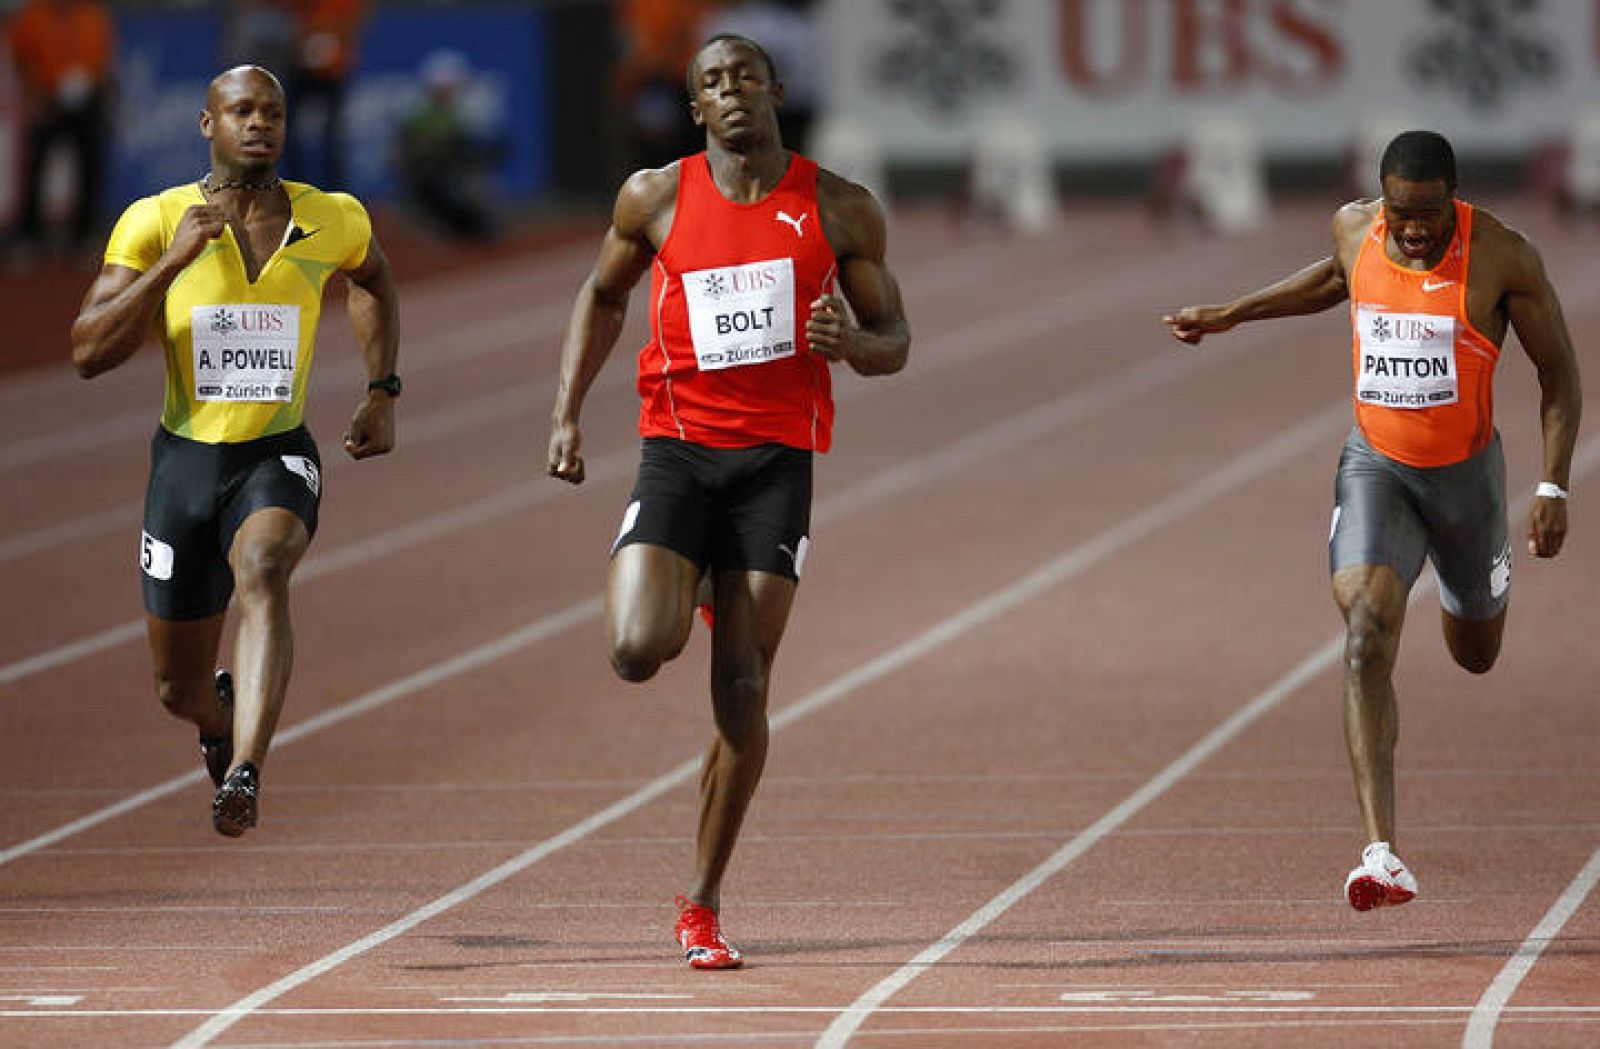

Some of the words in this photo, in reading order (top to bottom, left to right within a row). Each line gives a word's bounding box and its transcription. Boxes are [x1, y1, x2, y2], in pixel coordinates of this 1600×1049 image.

[1054, 0, 1346, 93] UBS
[732, 269, 777, 294] UBS
[241, 310, 283, 332] UBS
[715, 306, 774, 336] BOLT
[1395, 319, 1437, 341] UBS
[199, 348, 216, 370] A.
[221, 348, 294, 371] POWELL
[1365, 355, 1449, 378] PATTON
